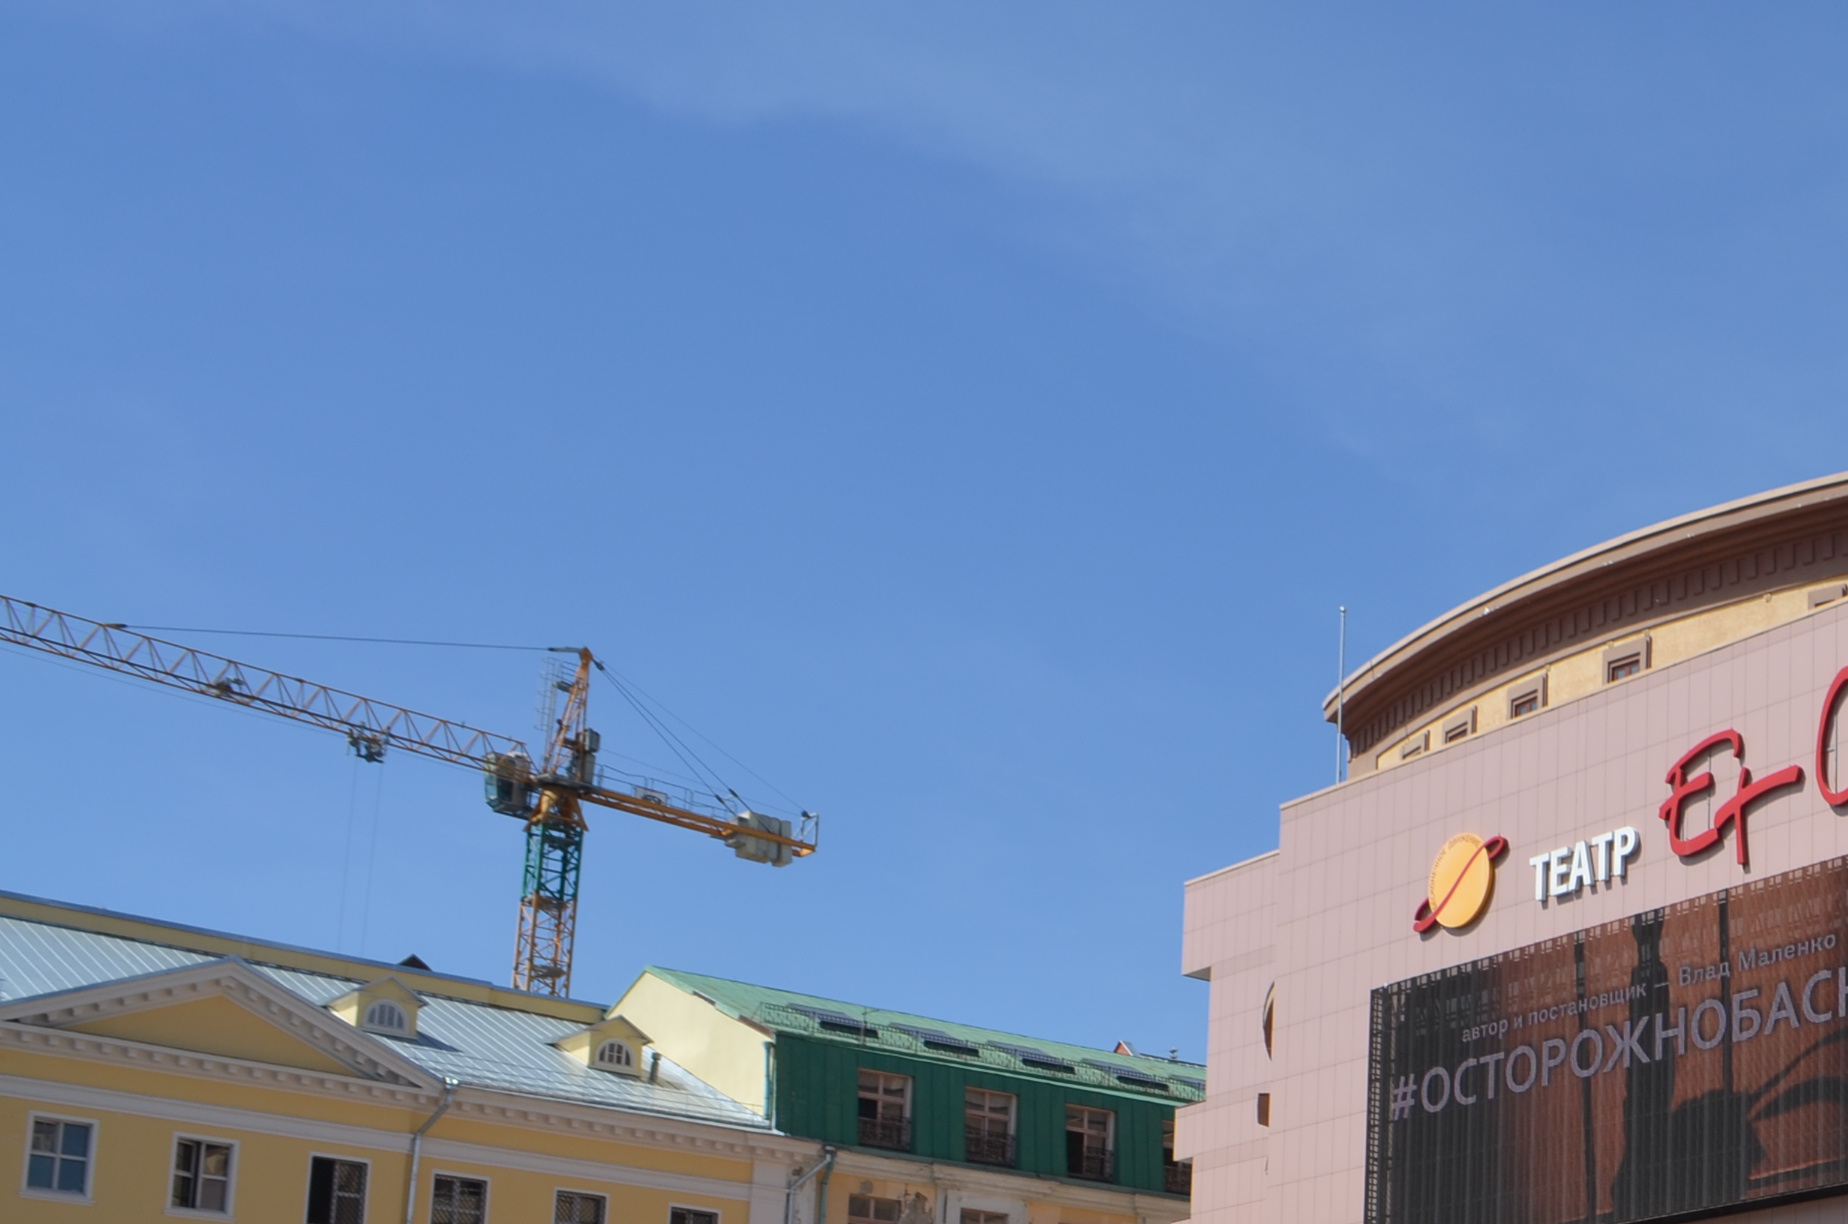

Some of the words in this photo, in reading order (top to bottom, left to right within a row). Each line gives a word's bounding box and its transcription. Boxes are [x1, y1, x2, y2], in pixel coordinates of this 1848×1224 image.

[1659, 729, 1803, 867] Et
[1530, 826, 1640, 902] ТЕАТР
[1461, 1018, 1509, 1044] автор
[1512, 1016, 1524, 1030] и
[1527, 982, 1648, 1025] постановщик
[1678, 949, 1731, 988] Влад
[1738, 931, 1837, 972] Маленко
